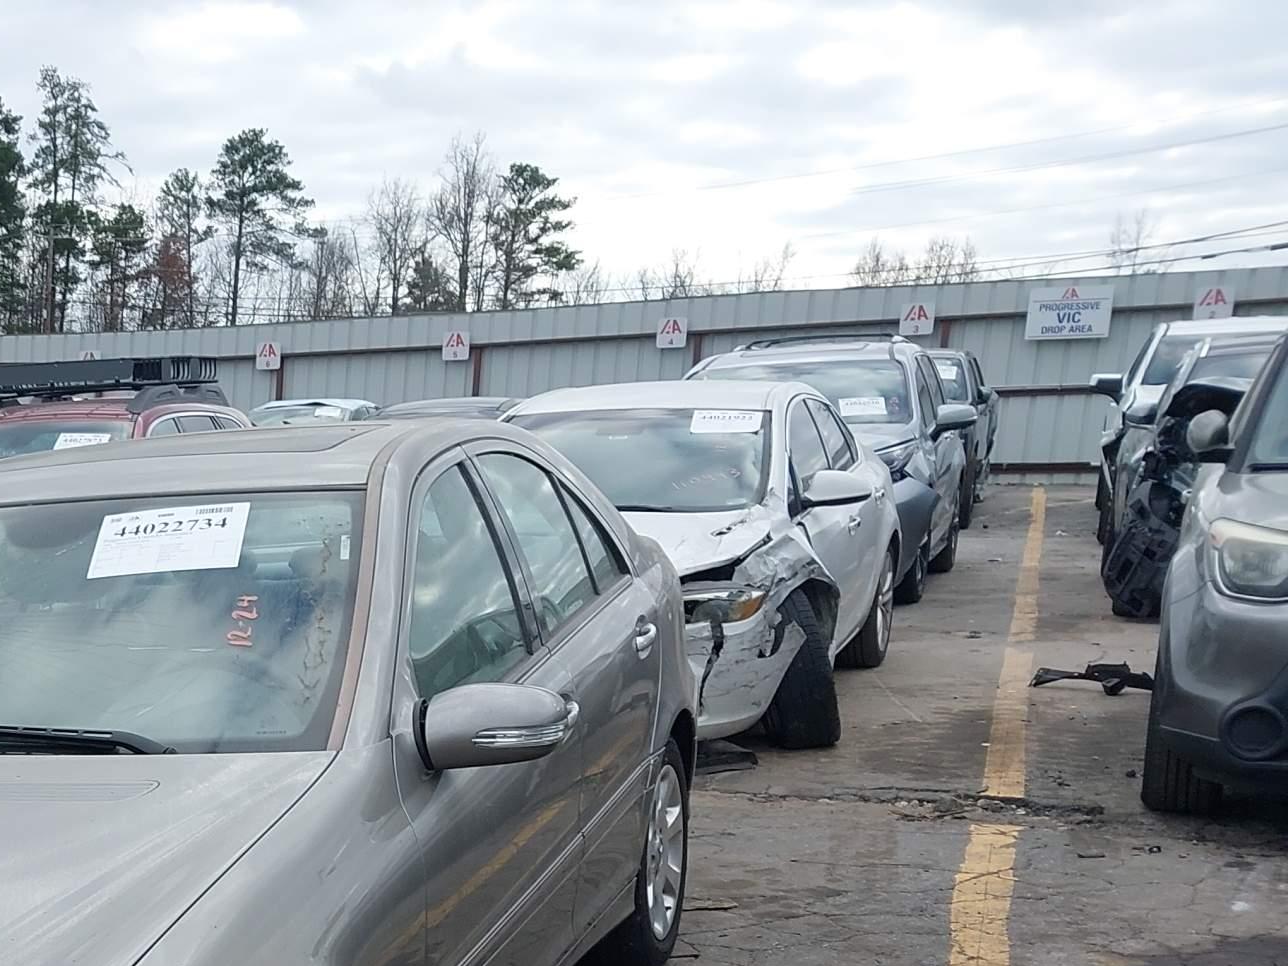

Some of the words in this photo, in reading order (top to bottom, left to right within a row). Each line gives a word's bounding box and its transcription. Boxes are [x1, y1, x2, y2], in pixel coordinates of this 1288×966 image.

[1039, 301, 1101, 312] PROGRESSIVE
[1057, 311, 1082, 324] VIC
[1041, 325, 1066, 335] DROP
[1068, 324, 1093, 334] AREA
[114, 516, 228, 537] 44022734
